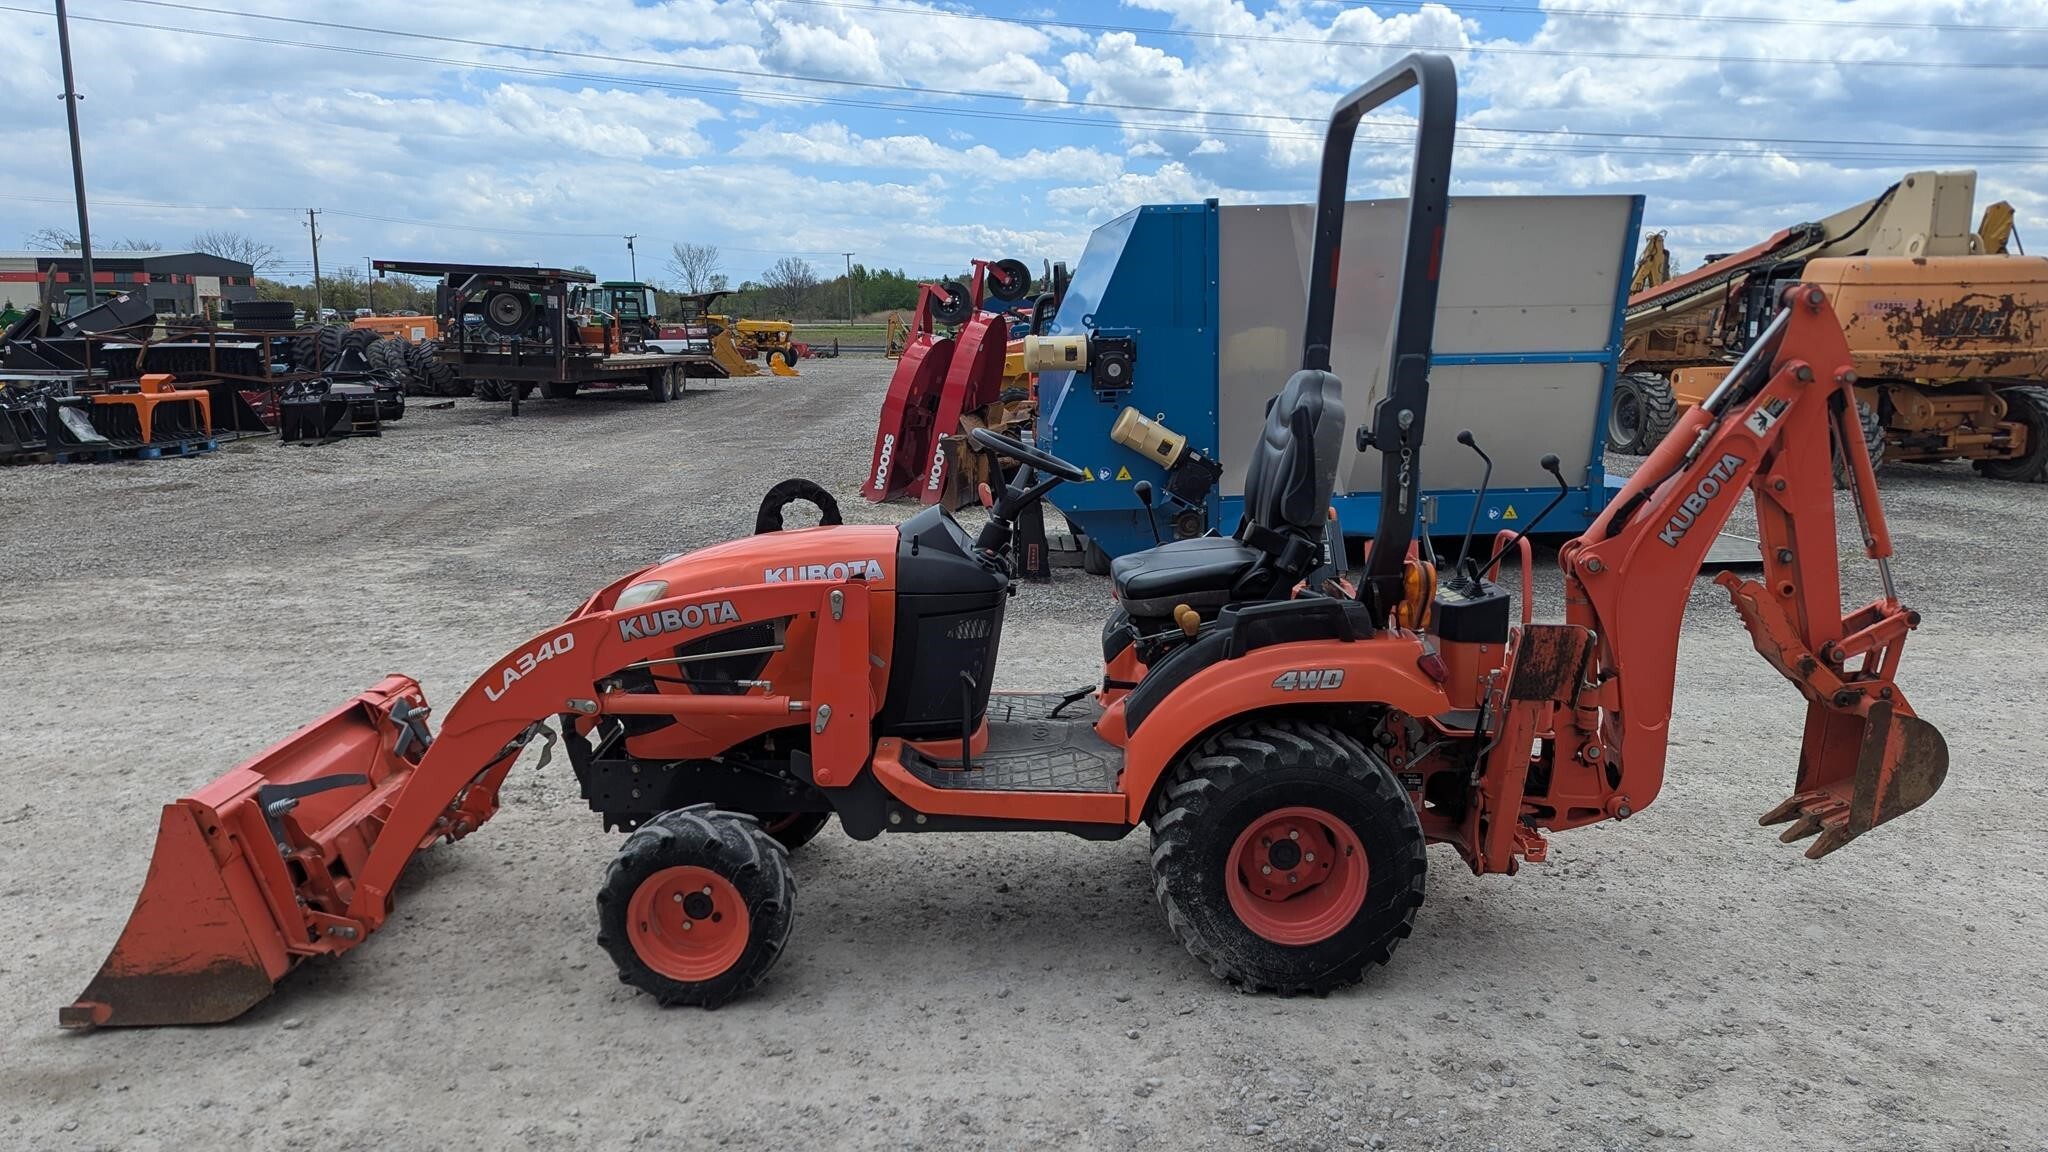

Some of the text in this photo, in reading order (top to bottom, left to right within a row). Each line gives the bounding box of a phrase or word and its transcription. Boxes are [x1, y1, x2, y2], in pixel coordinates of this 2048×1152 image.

[874, 433, 894, 490] WOODS
[1658, 453, 1745, 548] KUBOTA
[764, 559, 885, 584] KUBOTA
[618, 600, 742, 642] KUBOTA
[484, 632, 575, 702] LA340
[1272, 668, 1345, 691] 4WD
